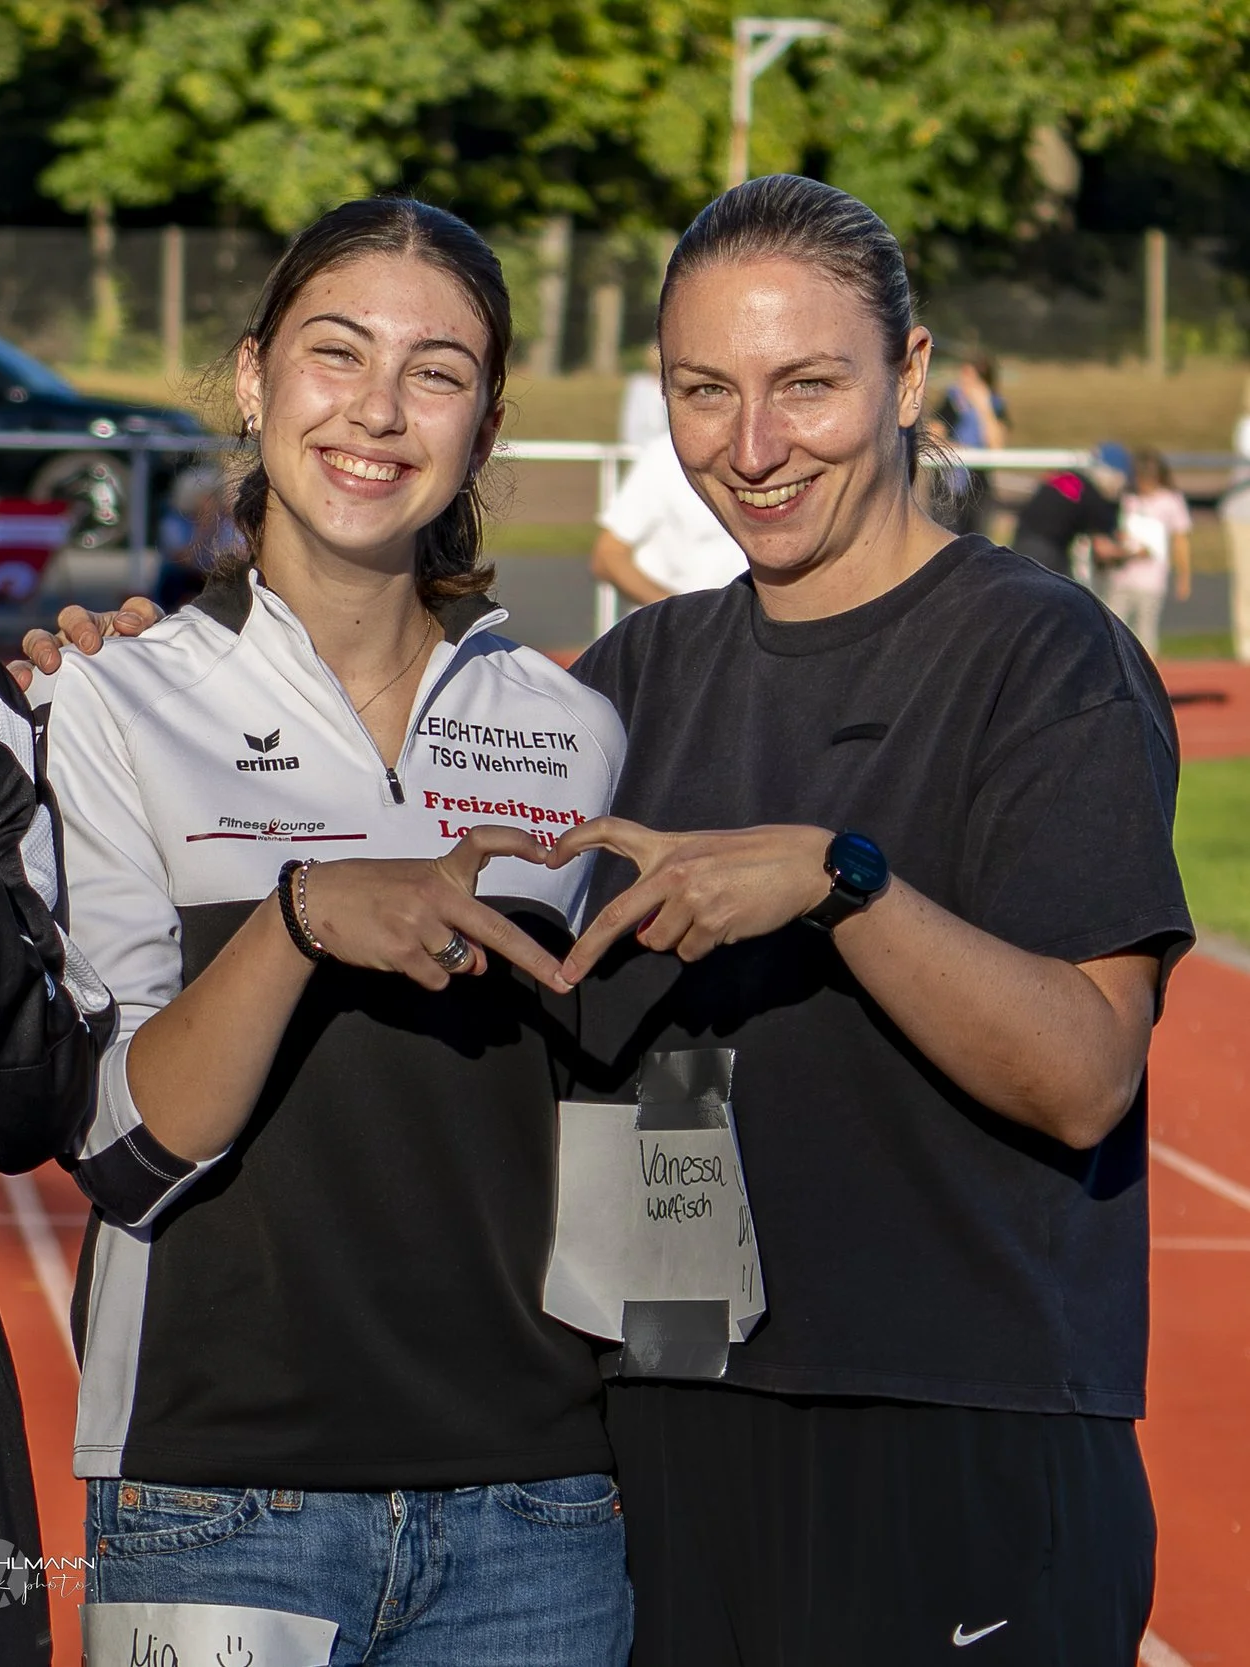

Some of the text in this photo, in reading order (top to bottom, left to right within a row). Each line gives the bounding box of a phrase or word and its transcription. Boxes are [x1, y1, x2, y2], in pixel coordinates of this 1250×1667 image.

[416, 716, 579, 753] LEICHTATHLETIK
[235, 756, 300, 772] erima
[429, 744, 568, 779] TSG Wehrheim
[423, 790, 587, 826] Freizeitpark
[639, 1139, 728, 1188] Vanessa
